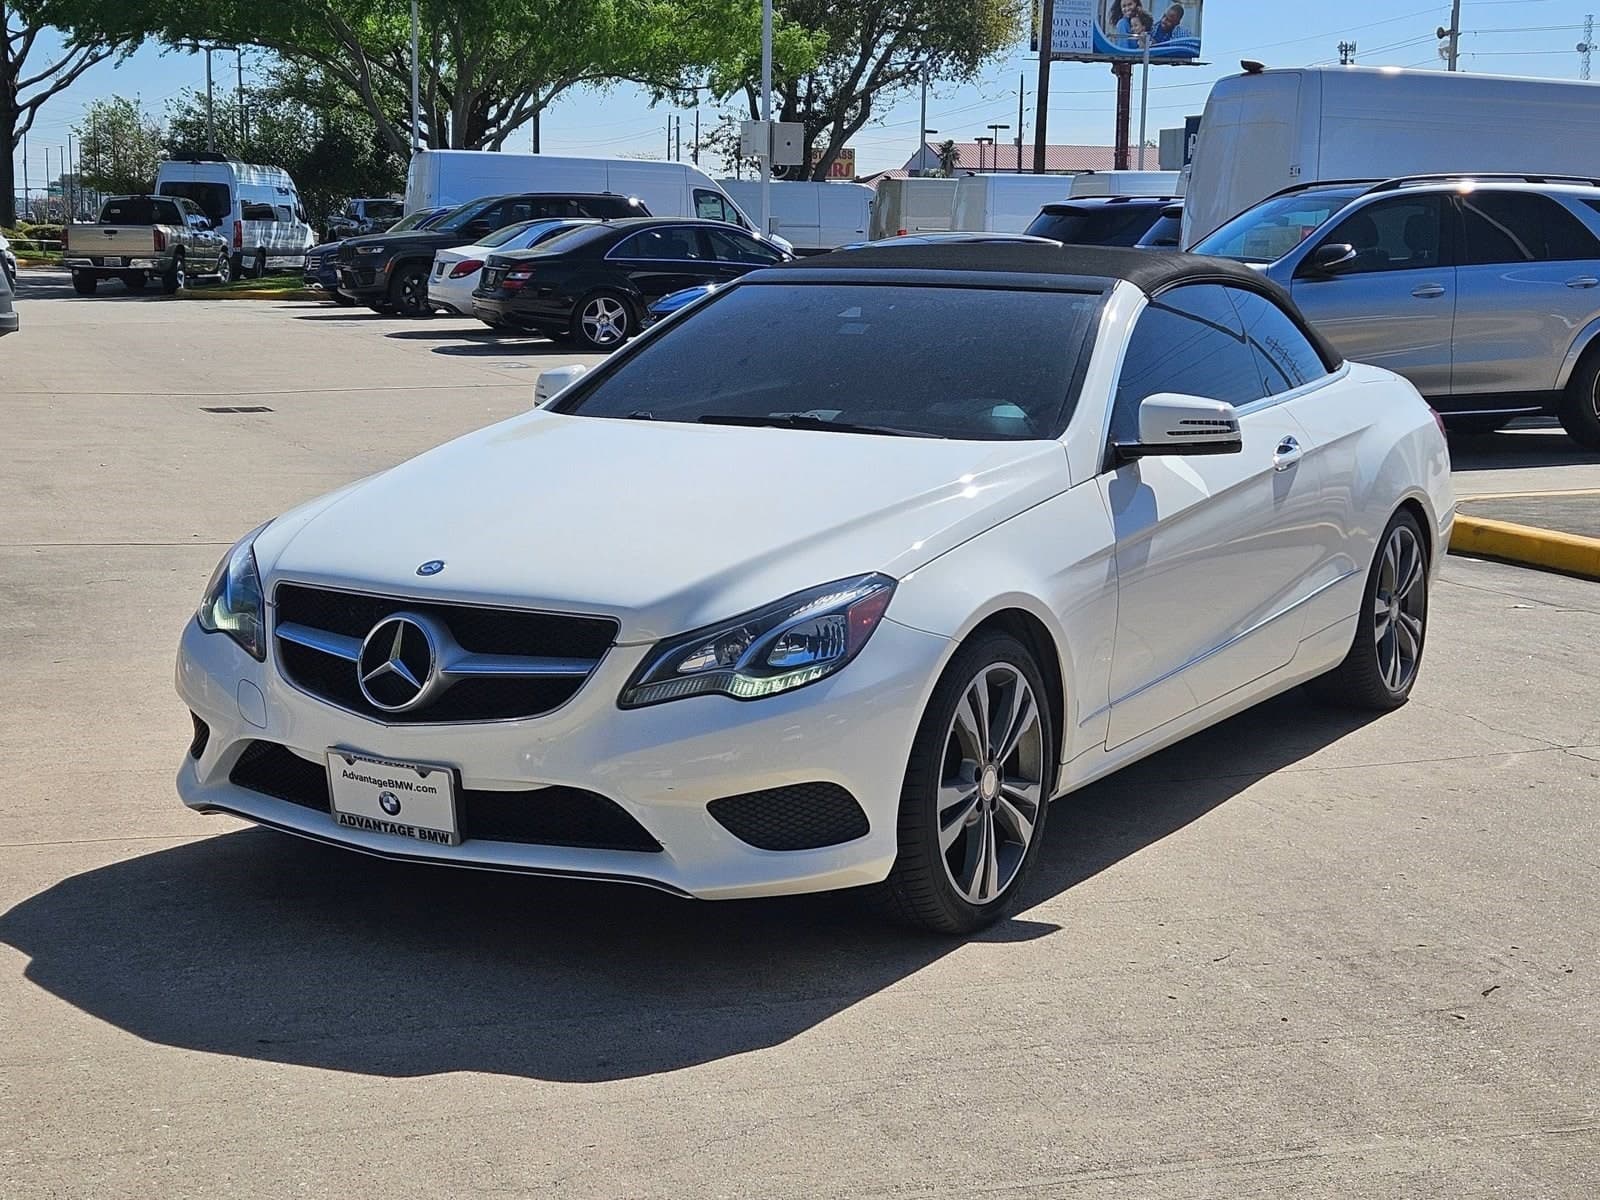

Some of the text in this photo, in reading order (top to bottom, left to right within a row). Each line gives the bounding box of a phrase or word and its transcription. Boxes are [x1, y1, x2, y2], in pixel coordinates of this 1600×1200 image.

[1075, 19, 1091, 27] US!
[1071, 41, 1091, 49] A.M.
[342, 769, 438, 794] AdvantageBMW.com
[340, 814, 450, 844] ADVANTAGE BMW
